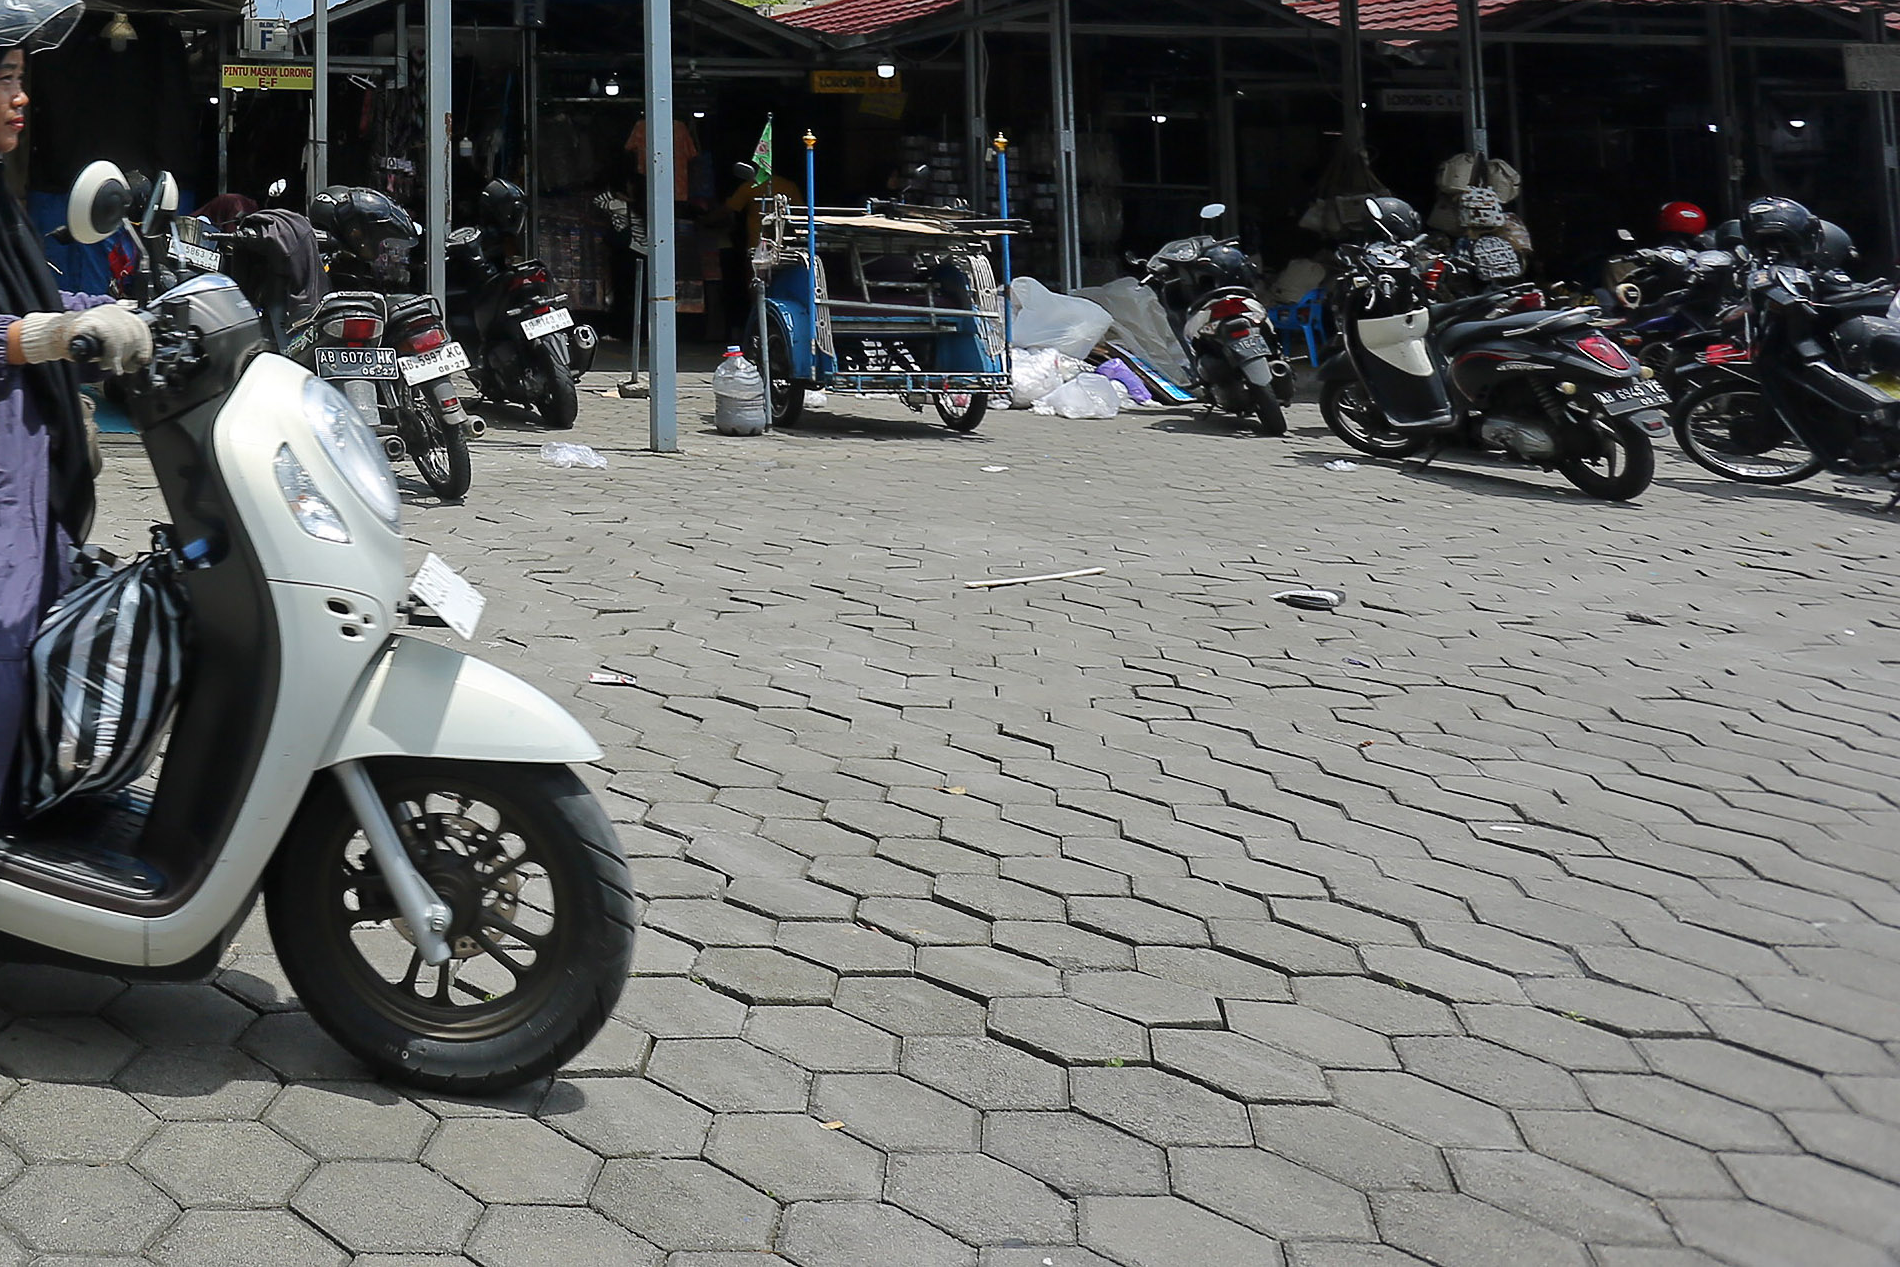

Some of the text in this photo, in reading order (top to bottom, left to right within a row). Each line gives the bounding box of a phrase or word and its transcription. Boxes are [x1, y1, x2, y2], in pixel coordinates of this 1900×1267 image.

[260, 29, 273, 51] F
[223, 66, 312, 78] PINTU MASUK LORONG
[258, 77, 278, 88] E-F
[185, 245, 206, 258] 5863
[320, 349, 395, 364] AB 6076 HK
[418, 350, 443, 368] 5997
[1593, 391, 1616, 405] AB
[1615, 384, 1645, 401] 6945
